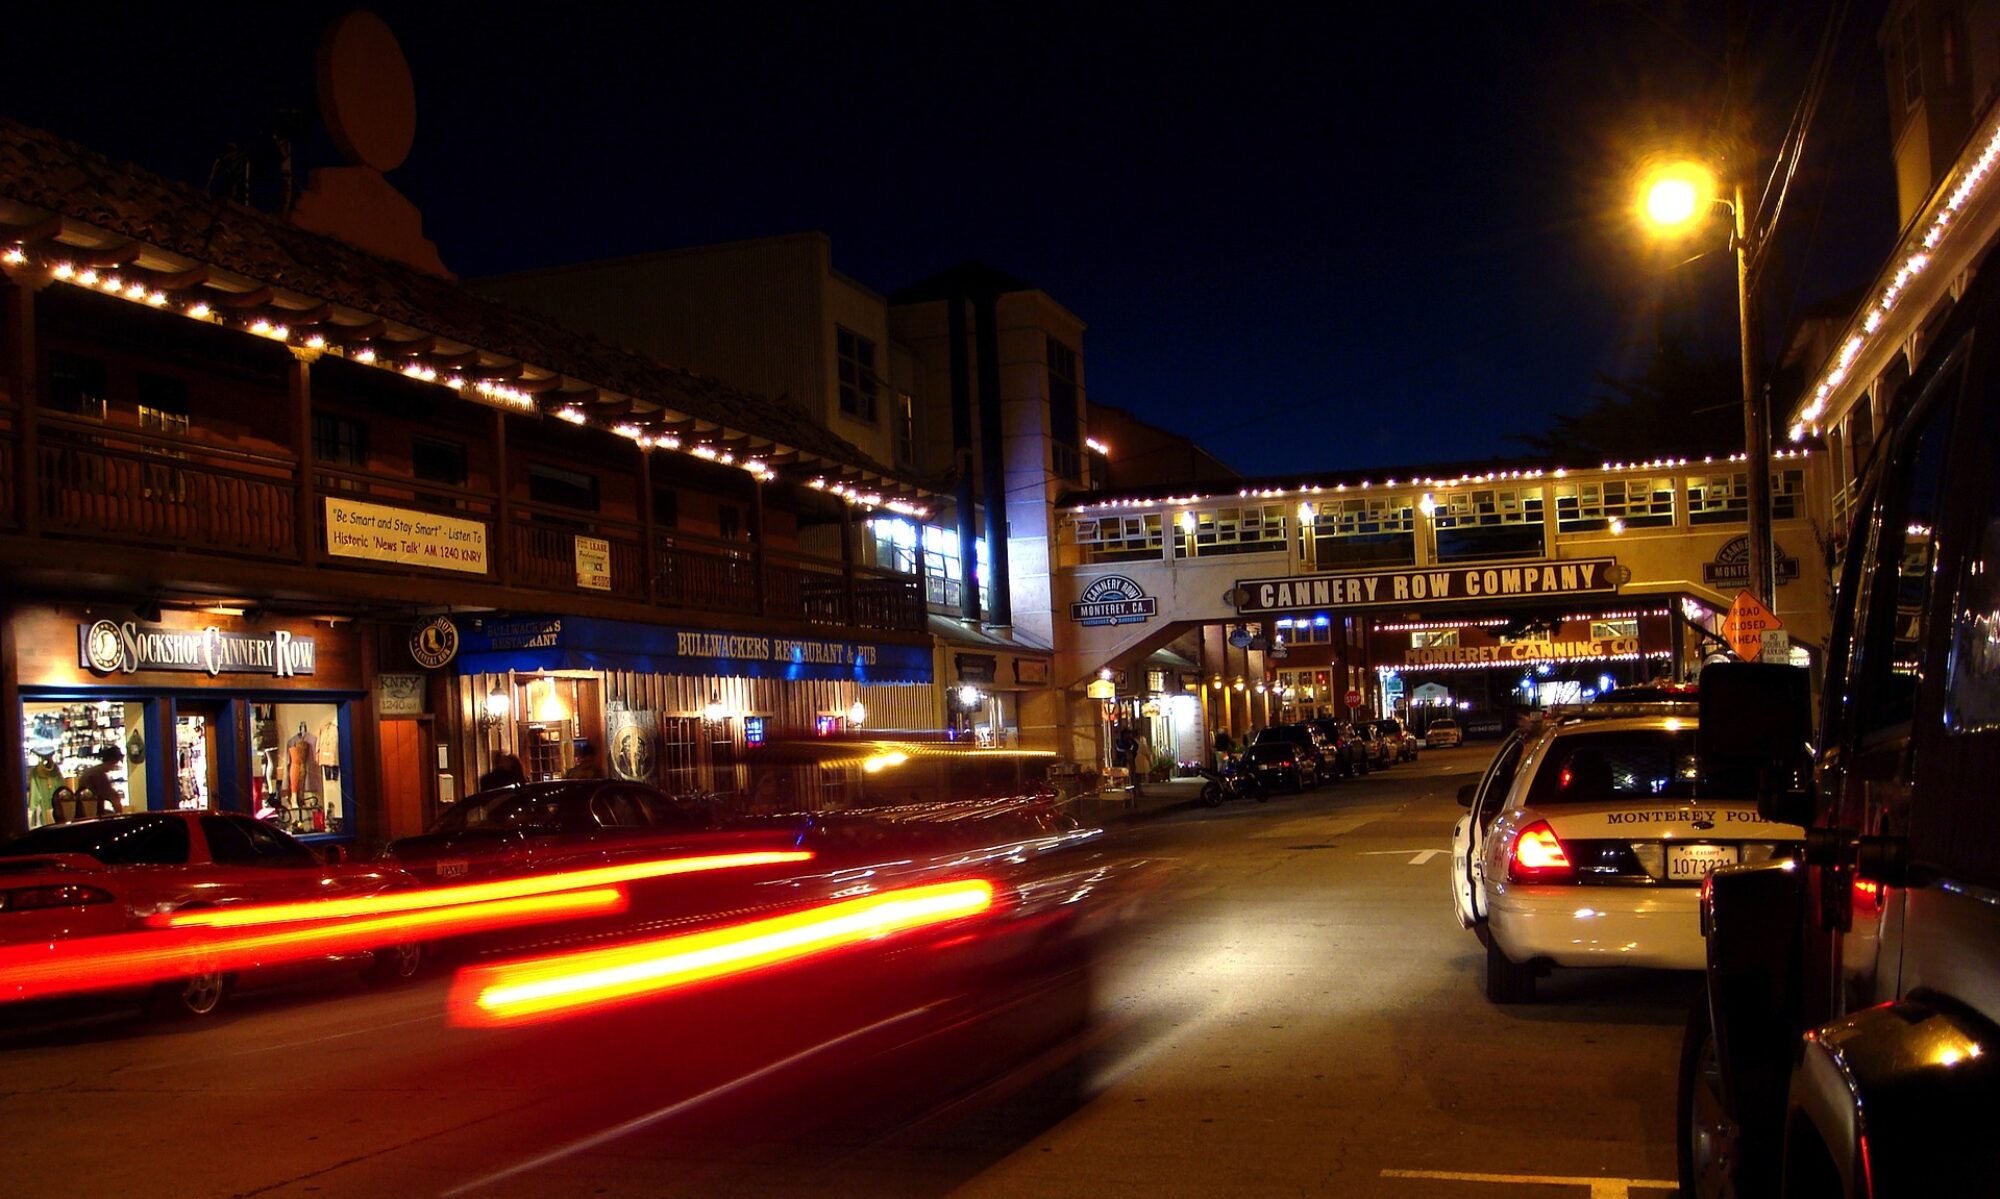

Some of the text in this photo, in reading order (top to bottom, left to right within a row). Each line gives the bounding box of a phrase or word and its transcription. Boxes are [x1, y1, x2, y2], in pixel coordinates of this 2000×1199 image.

[349, 512, 376, 527] Smart
[377, 517, 393, 530] and
[394, 519, 413, 536] Stay
[415, 522, 442, 537] Smart"
[448, 527, 471, 542] Listen
[472, 531, 482, 543] To
[333, 531, 481, 563] Historic 'News Talk' AM 1240 KNRY
[1086, 579, 1139, 602] CANNERY ROW
[1260, 564, 1596, 608] CANNERY ROW COMPANY
[1733, 607, 1760, 617] ROAD
[1731, 620, 1766, 631] CLOSED
[122, 621, 314, 676] SOCKSHOP CANNERY ROW
[492, 633, 557, 650] RESTAURANT
[677, 632, 877, 666] BULLWACKERS RESTAURANT & PUB
[1404, 638, 1639, 665] MONTEREY CANNING CO
[380, 675, 420, 691] KNRY
[1346, 695, 1360, 704] STOP
[1607, 811, 1768, 824] MONTEREY POL
